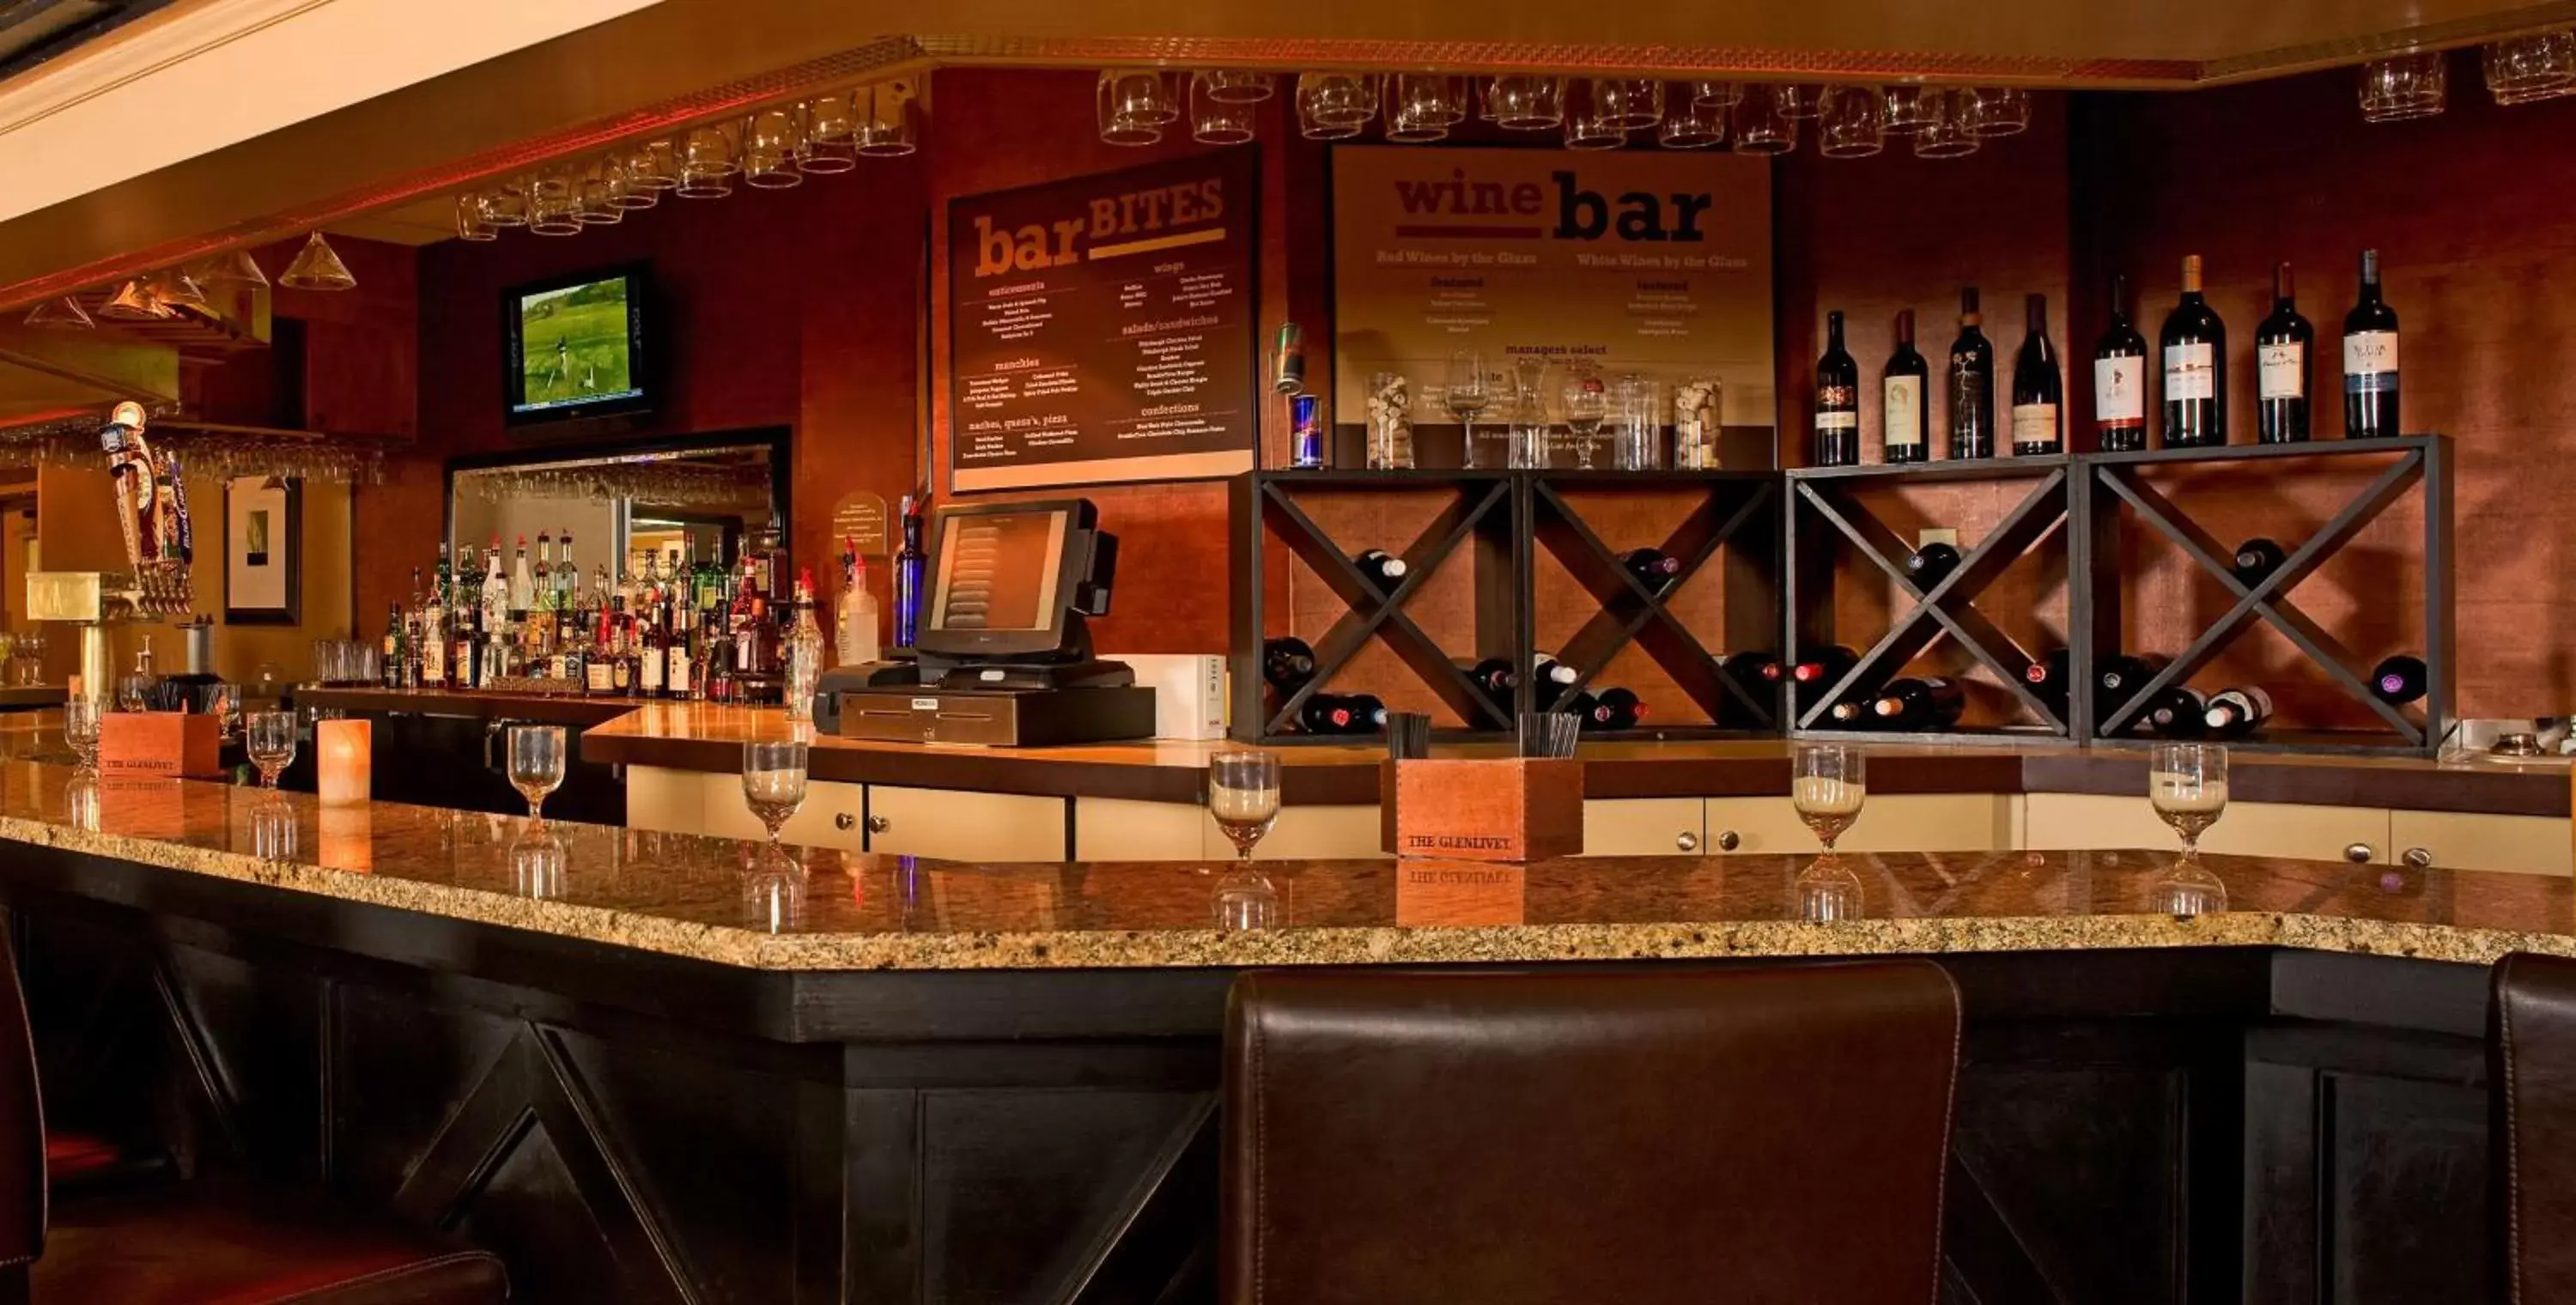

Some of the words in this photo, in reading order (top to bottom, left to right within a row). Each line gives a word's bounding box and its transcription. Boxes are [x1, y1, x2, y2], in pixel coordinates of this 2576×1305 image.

[1395, 168, 1543, 215] wine
[1552, 171, 1711, 242] bar
[975, 216, 1084, 276] bar
[1089, 178, 1224, 240] BITES
[1376, 251, 1404, 263] Red
[1406, 251, 1448, 263] Wines
[1451, 252, 1469, 268] by
[1473, 252, 1493, 264] the
[1498, 252, 1537, 264] Glass
[1577, 253, 1617, 266] White
[1619, 254, 1661, 267] Wines
[1664, 255, 1680, 269] by
[1684, 256, 1704, 267] the
[1708, 255, 1748, 267] Glass
[1571, 345, 1607, 355] select
[995, 357, 1040, 371] munchies
[1141, 404, 1199, 416] confections
[1408, 835, 1435, 847] THE
